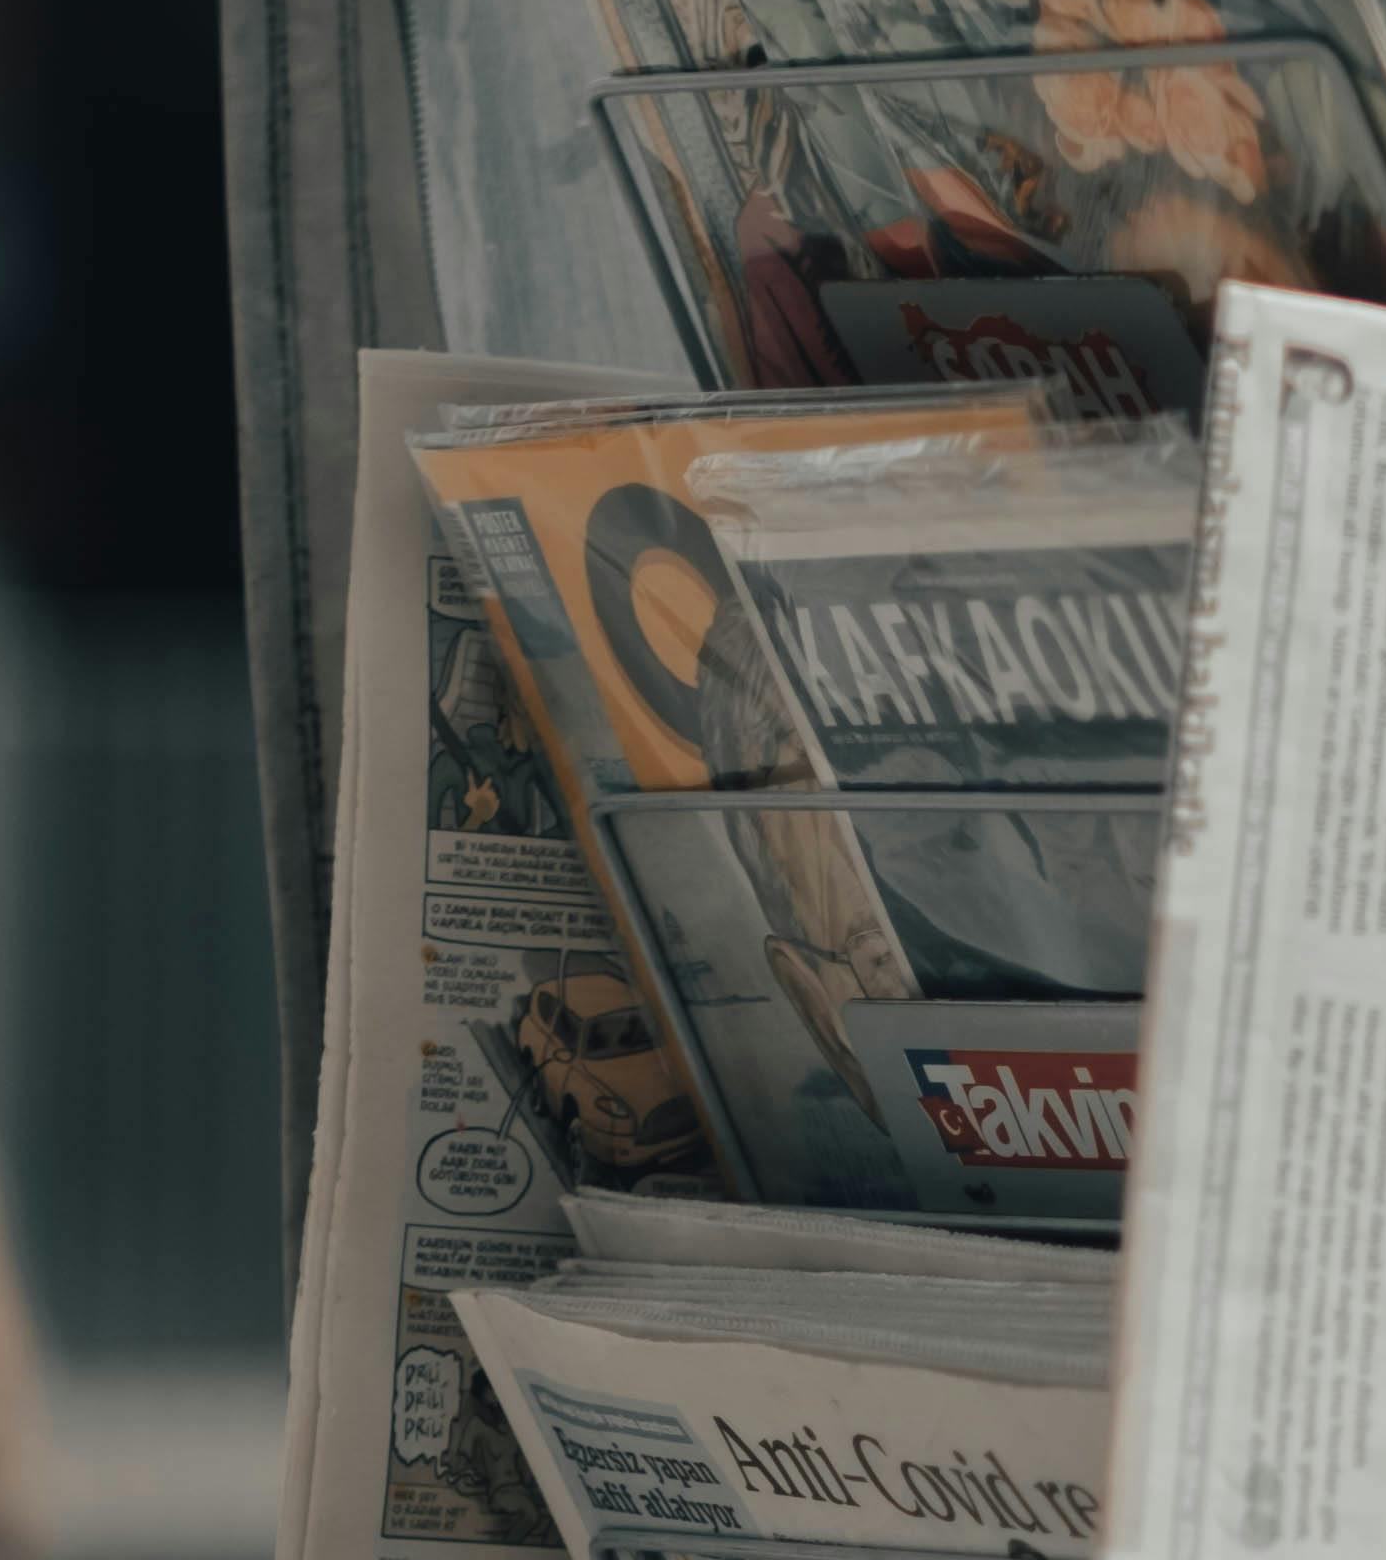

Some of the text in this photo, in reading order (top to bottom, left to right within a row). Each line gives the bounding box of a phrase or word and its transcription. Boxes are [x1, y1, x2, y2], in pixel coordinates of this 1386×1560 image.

[791, 593, 1190, 730] KAFKAOKU
[554, 1426, 720, 1486] Egzersiz yapan
[715, 1414, 1053, 1534] Anti-Covid
[588, 1474, 743, 1533] hafif atlatıyor
